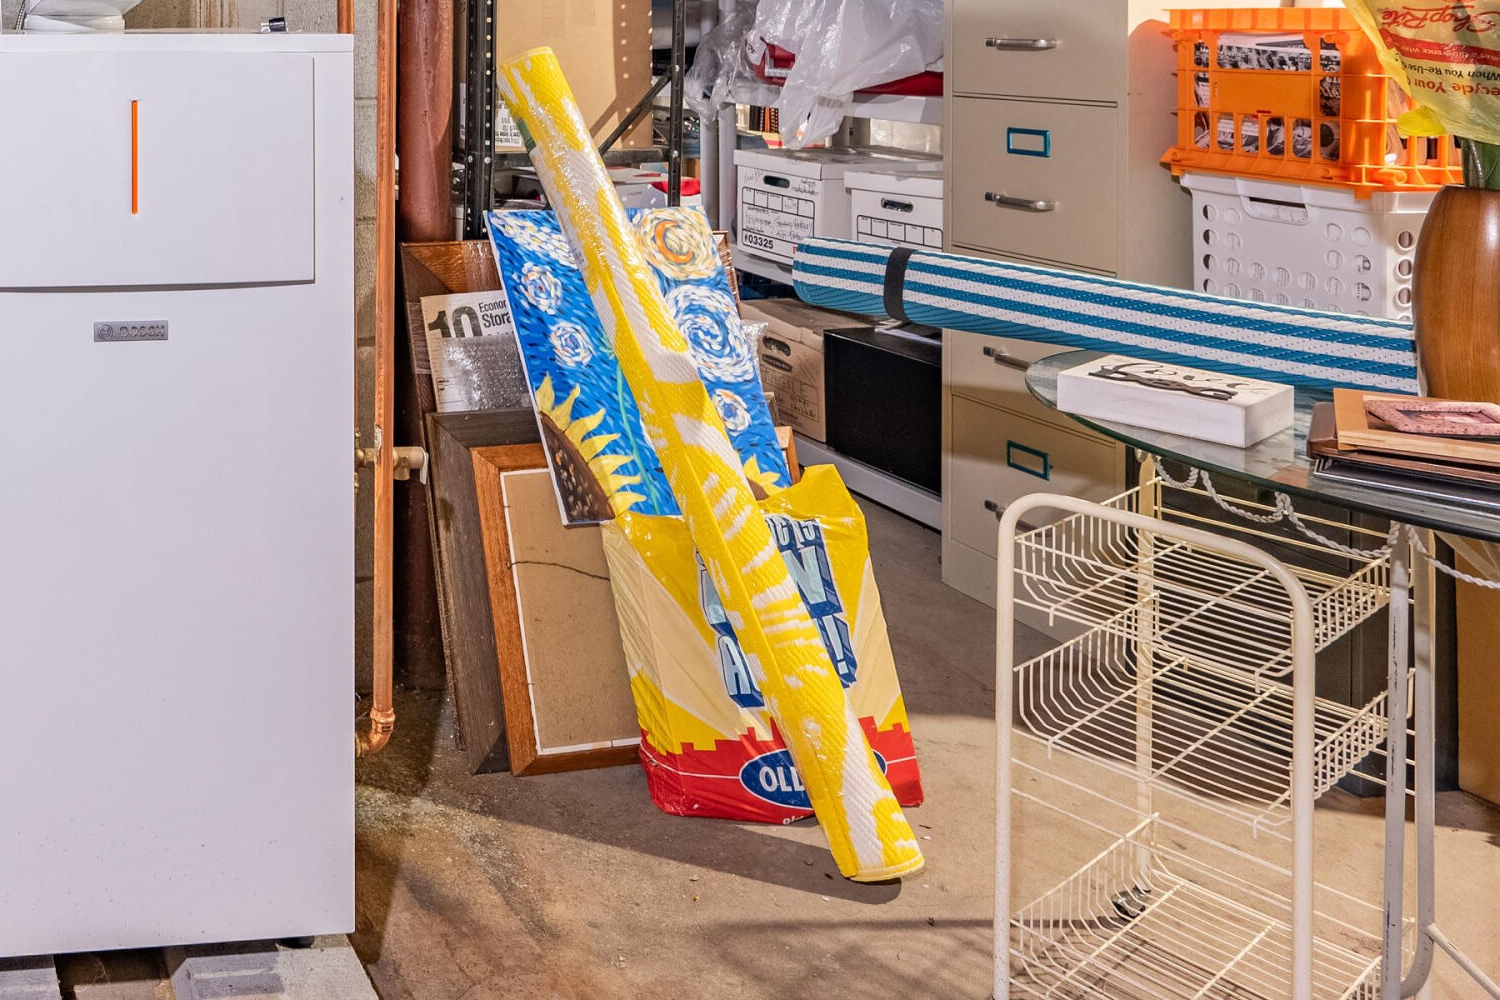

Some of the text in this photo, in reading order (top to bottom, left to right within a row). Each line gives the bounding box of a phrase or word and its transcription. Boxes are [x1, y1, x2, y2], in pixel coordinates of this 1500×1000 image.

[1444, 68, 1464, 79] You
[1451, 82, 1500, 98] ecycle
[743, 234, 774, 250] #03325
[481, 311, 512, 329] Stora
[119, 325, 165, 337] BOSCH
